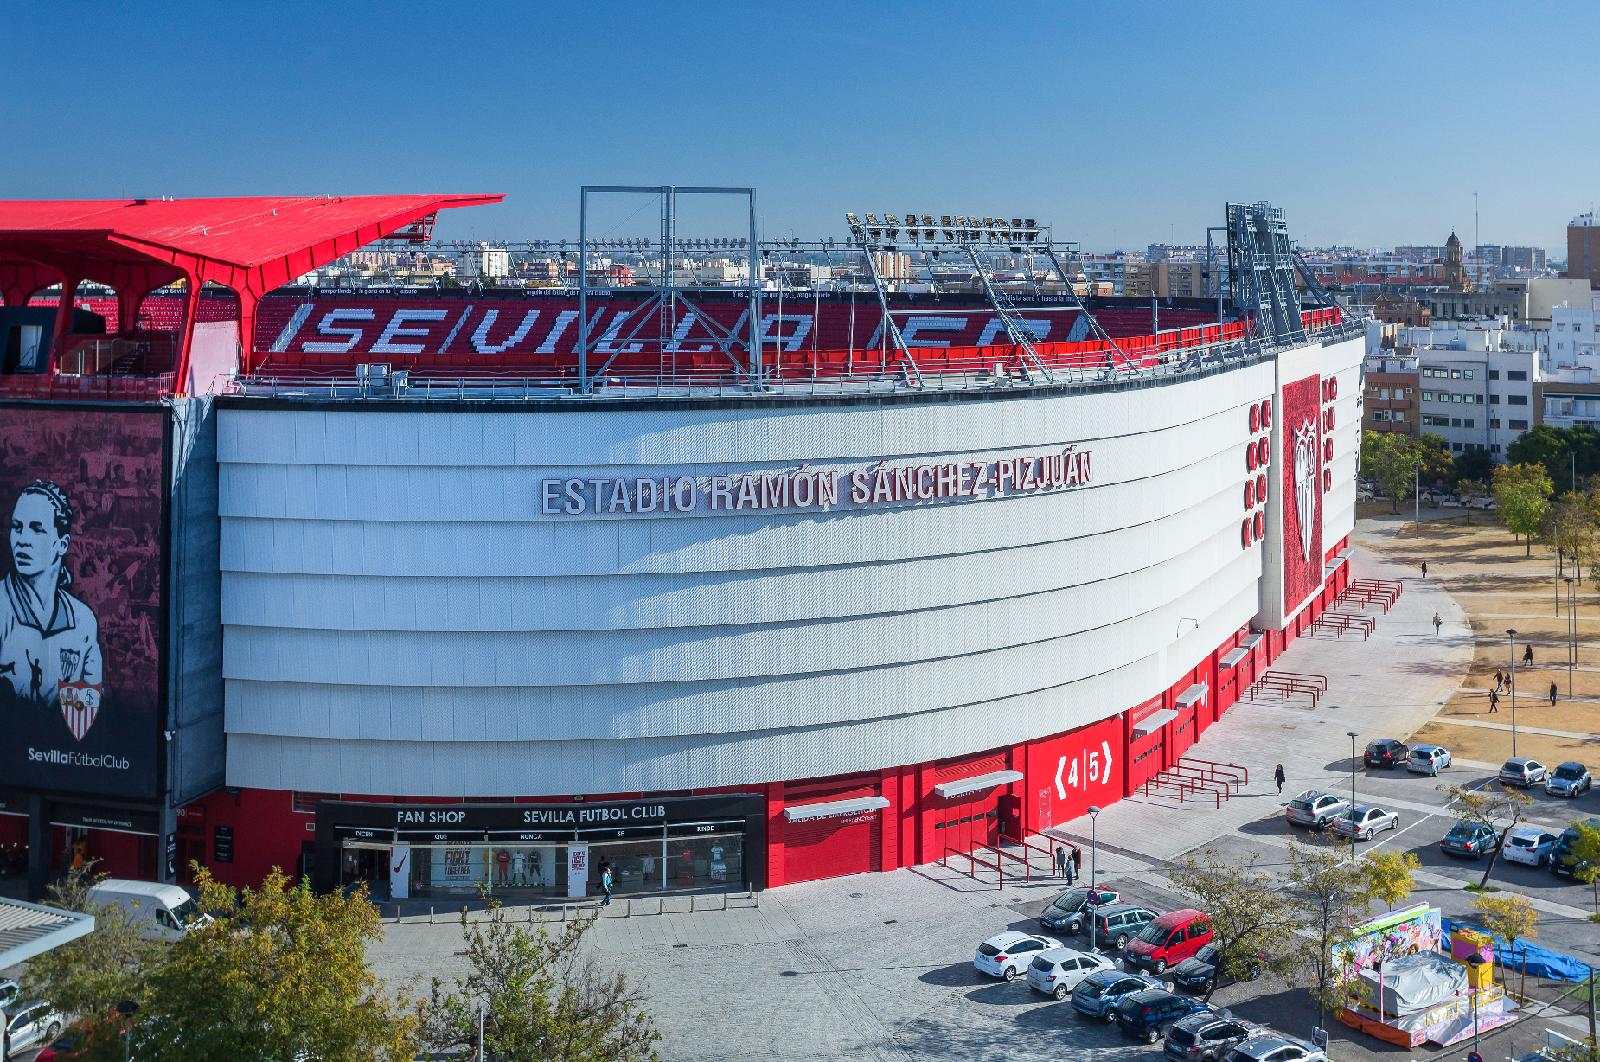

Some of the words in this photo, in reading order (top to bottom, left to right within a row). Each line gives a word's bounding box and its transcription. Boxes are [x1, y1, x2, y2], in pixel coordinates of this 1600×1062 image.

[541, 476, 697, 514] ESTADIO
[711, 463, 838, 510] RAMÓN
[852, 445, 1093, 503] SÁNCHEZ-PIZJUÁN
[397, 811, 425, 823] FAN
[429, 811, 466, 823] SHOP
[523, 810, 575, 823] SEVILLA
[579, 808, 628, 822] FUTBOL
[631, 806, 666, 818] CLUB
